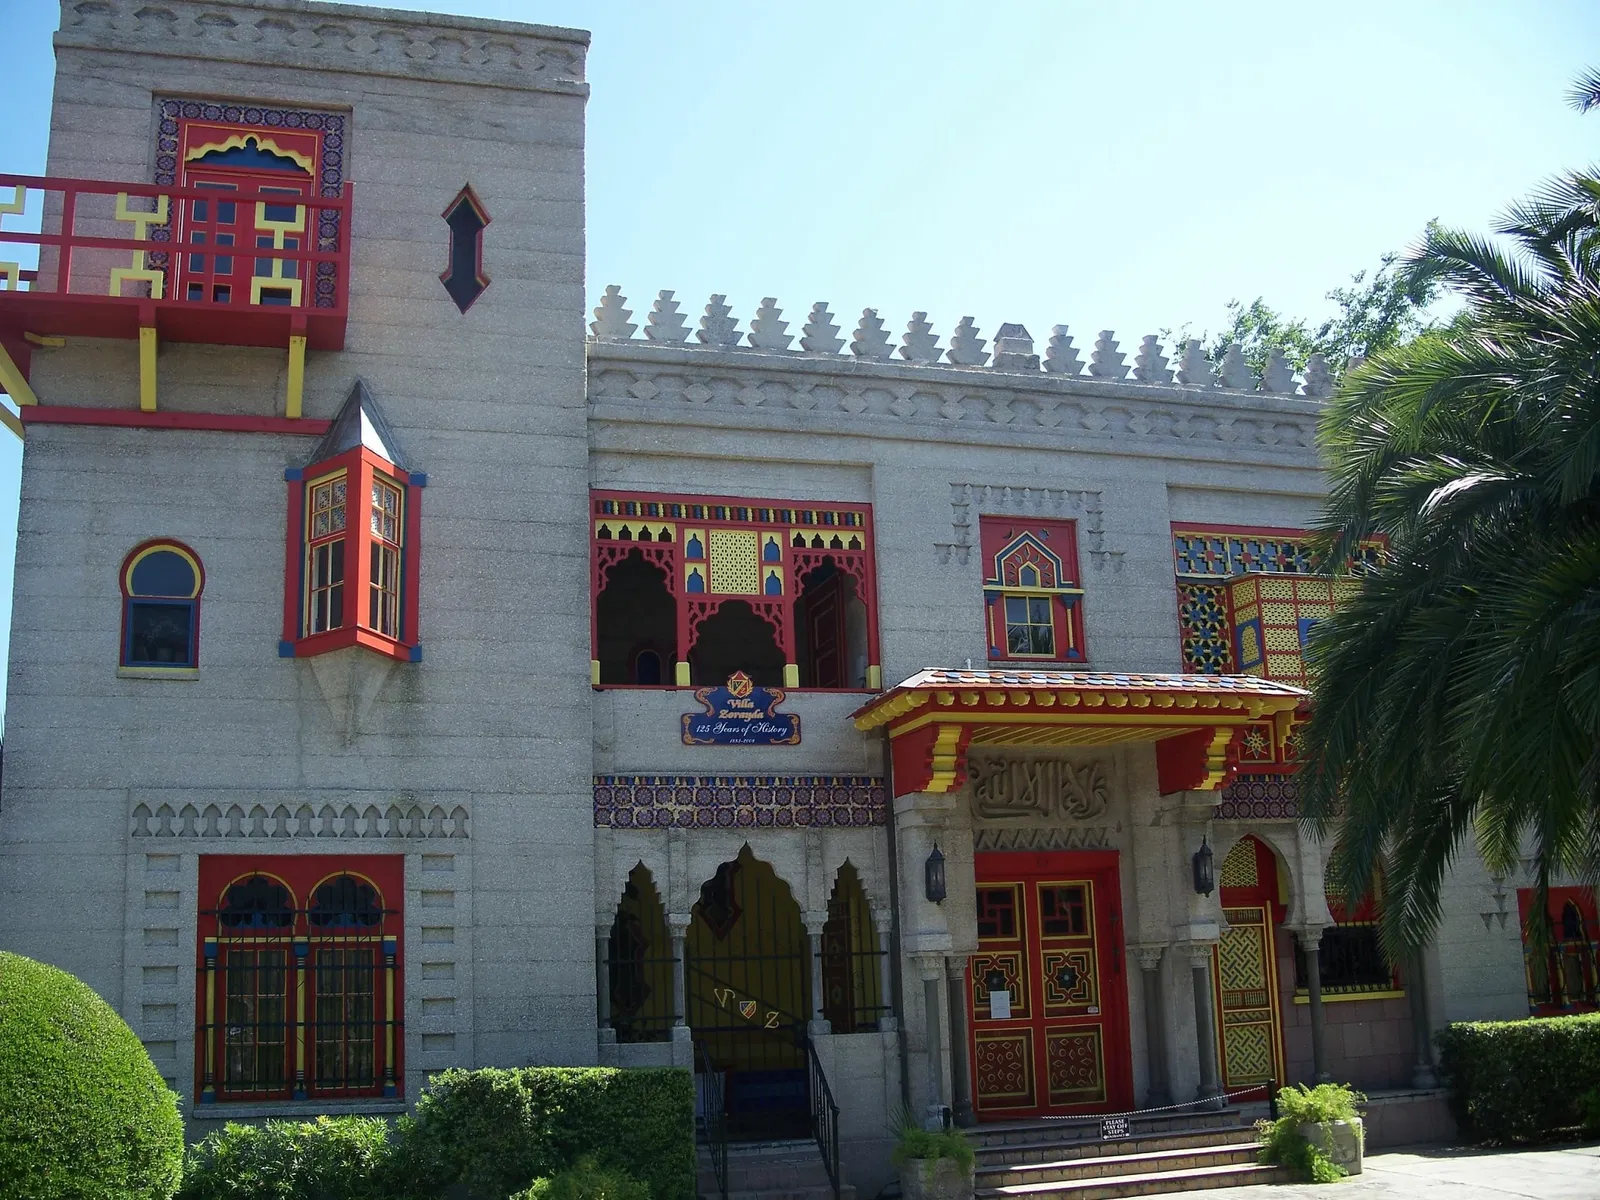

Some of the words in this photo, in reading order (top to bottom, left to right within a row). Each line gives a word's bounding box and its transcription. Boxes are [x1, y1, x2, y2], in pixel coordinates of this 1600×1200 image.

[726, 699, 754, 709] Villa
[718, 709, 764, 722] Zorayda
[696, 724, 710, 733] 125
[712, 721, 740, 734] Years
[741, 723, 750, 736] of
[751, 721, 787, 737] History
[713, 988, 736, 1009] V
[764, 1011, 779, 1029] Z
